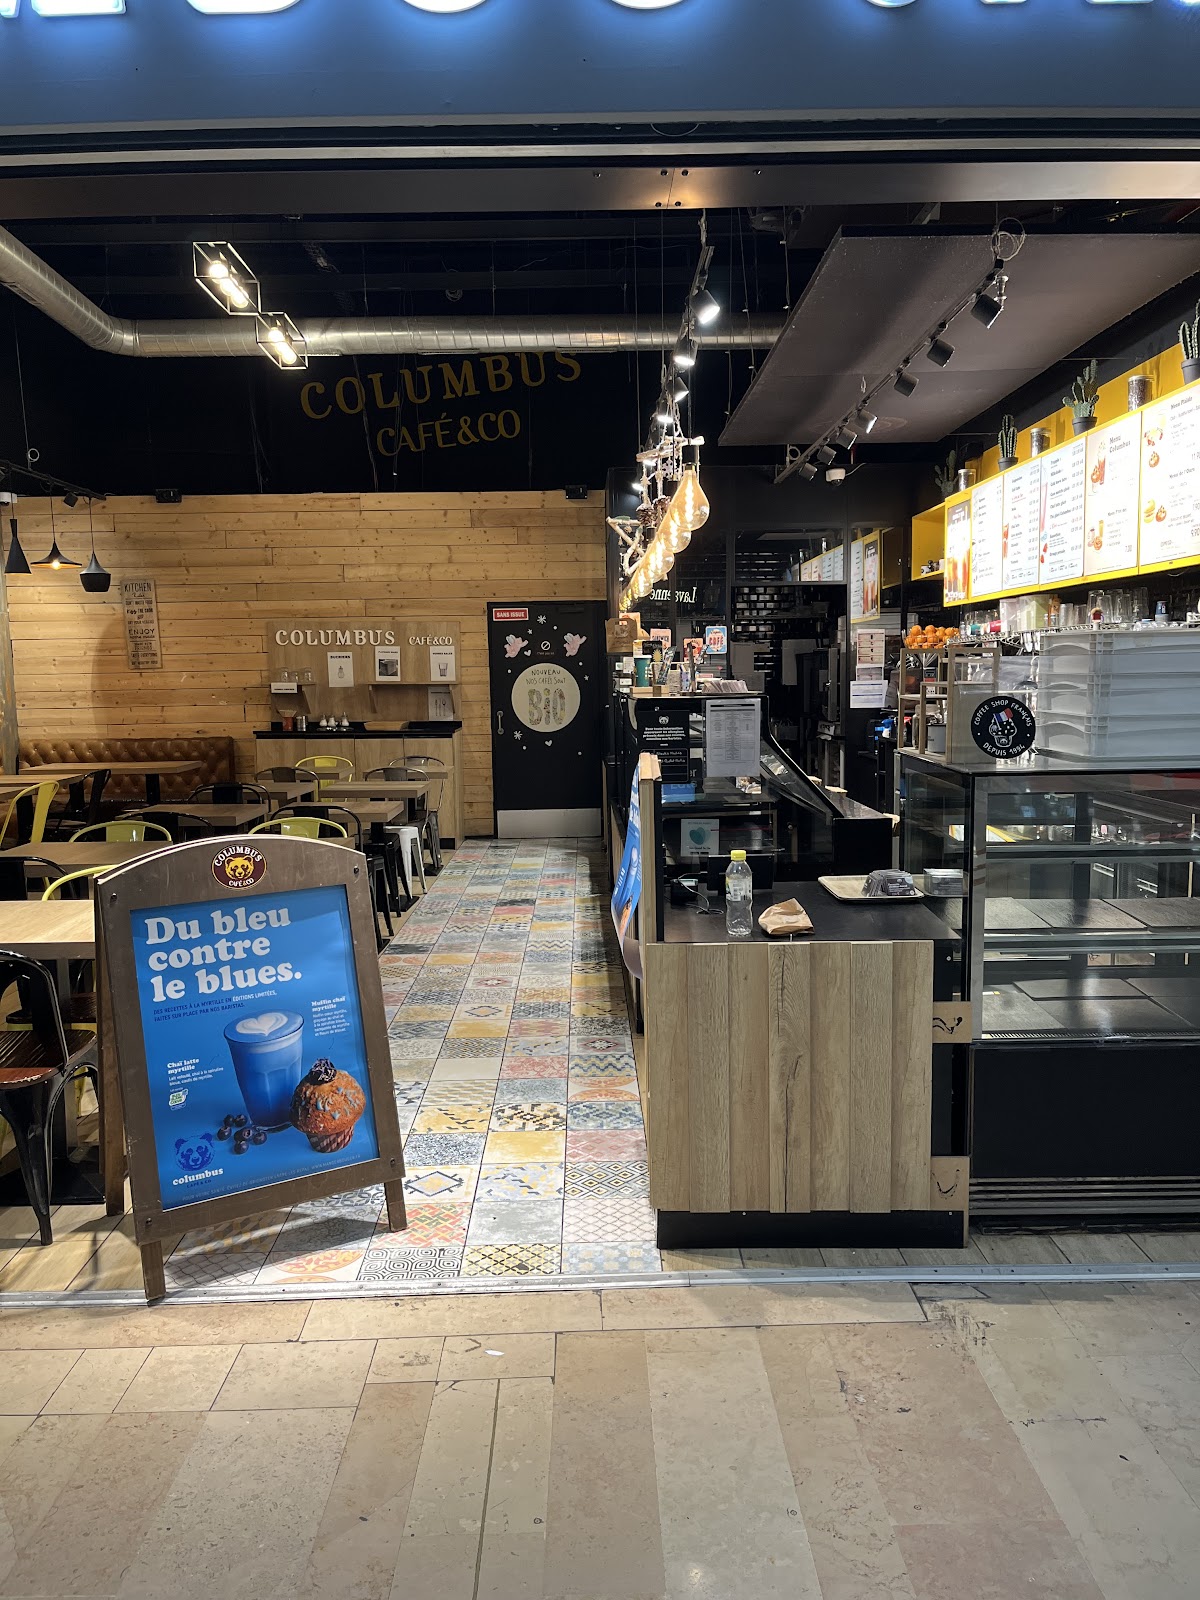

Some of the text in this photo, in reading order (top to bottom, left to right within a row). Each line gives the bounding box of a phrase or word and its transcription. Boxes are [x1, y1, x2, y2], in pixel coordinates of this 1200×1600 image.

[300, 352, 582, 420] COLUMBUS
[376, 411, 521, 457] CAFÉ&CO
[124, 583, 152, 592] KITCHEN
[129, 628, 155, 636] ENJOY
[275, 629, 396, 647] COLUMBUS
[408, 633, 454, 646] CAFÉ&CO
[974, 699, 1033, 727] COFFEE SHOP FRANÇAIS
[982, 742, 1007, 757] DEPUIS
[214, 845, 263, 866] COLUMBUS
[145, 906, 290, 945] Du bleu
[148, 934, 271, 972] contre
[151, 960, 302, 1003] le blues.
[164, 1004, 188, 1013] RECETTES
[200, 999, 225, 1008] MYRTILLE
[312, 1004, 337, 1013] myrtille
[154, 1014, 171, 1022] FAITES
[182, 1009, 198, 1017] PLACE
[199, 1007, 209, 1015] PAR
[167, 1065, 196, 1075] myrtille
[183, 1058, 200, 1066] latte
[172, 1167, 224, 1187] columbus
